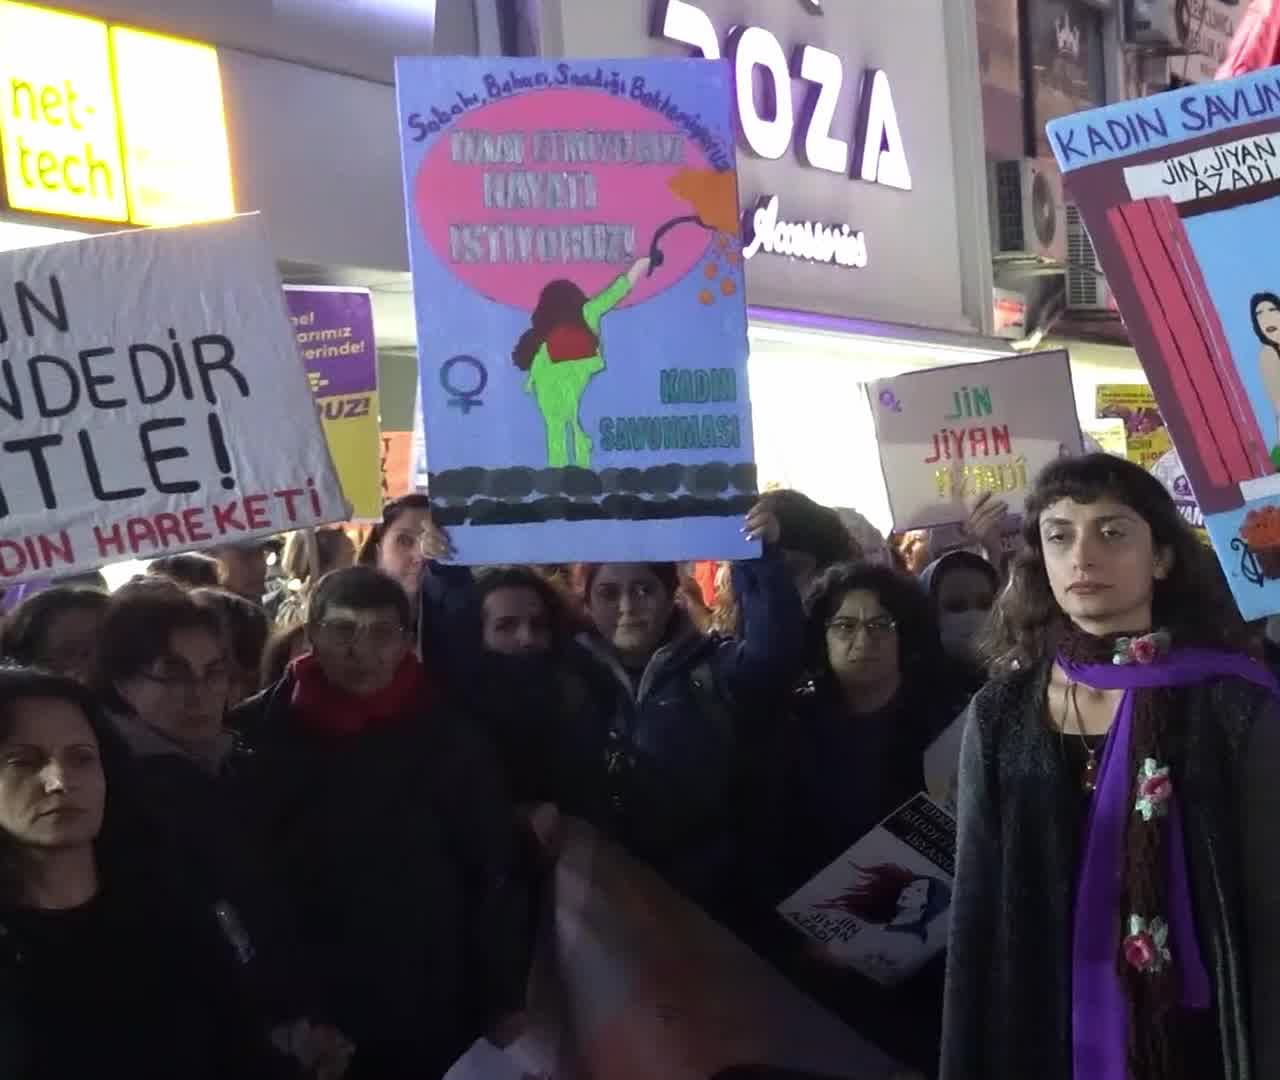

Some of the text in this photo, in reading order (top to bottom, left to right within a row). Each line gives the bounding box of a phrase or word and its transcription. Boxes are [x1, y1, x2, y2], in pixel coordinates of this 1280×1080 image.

[1055, 107, 1169, 163] KADIN
[16, 136, 113, 199] tech
[944, 385, 993, 419] JİN
[0, 412, 236, 518] TLE!
[924, 424, 1012, 464] JİYAN
[94, 477, 322, 556] HAREKETİ
